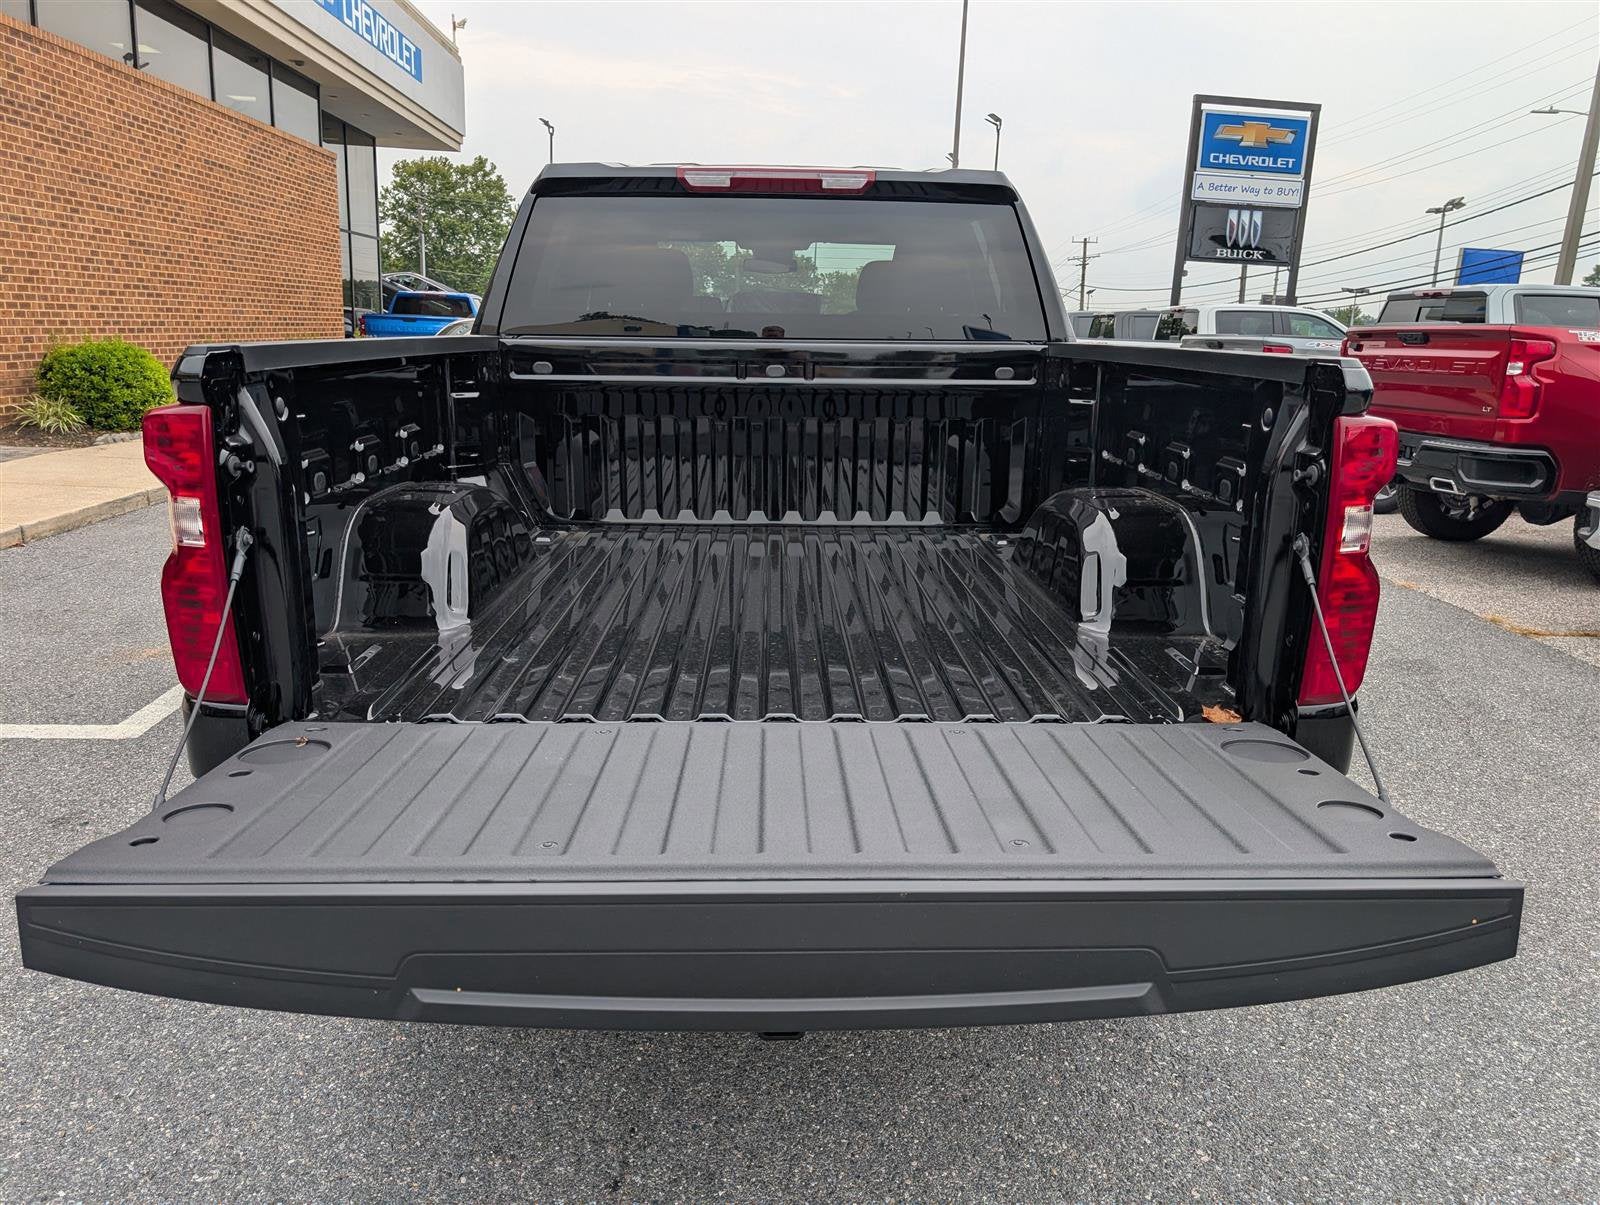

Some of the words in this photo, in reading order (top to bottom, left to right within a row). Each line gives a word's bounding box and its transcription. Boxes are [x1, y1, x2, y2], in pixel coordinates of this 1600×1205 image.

[1210, 153, 1296, 168] CHEVROLET
[1196, 182, 1205, 191] A
[1208, 182, 1239, 193] Better
[1241, 185, 1260, 197] Way
[1263, 186, 1273, 195] to
[1276, 187, 1299, 197] BUY!
[1216, 248, 1263, 259] BUICK
